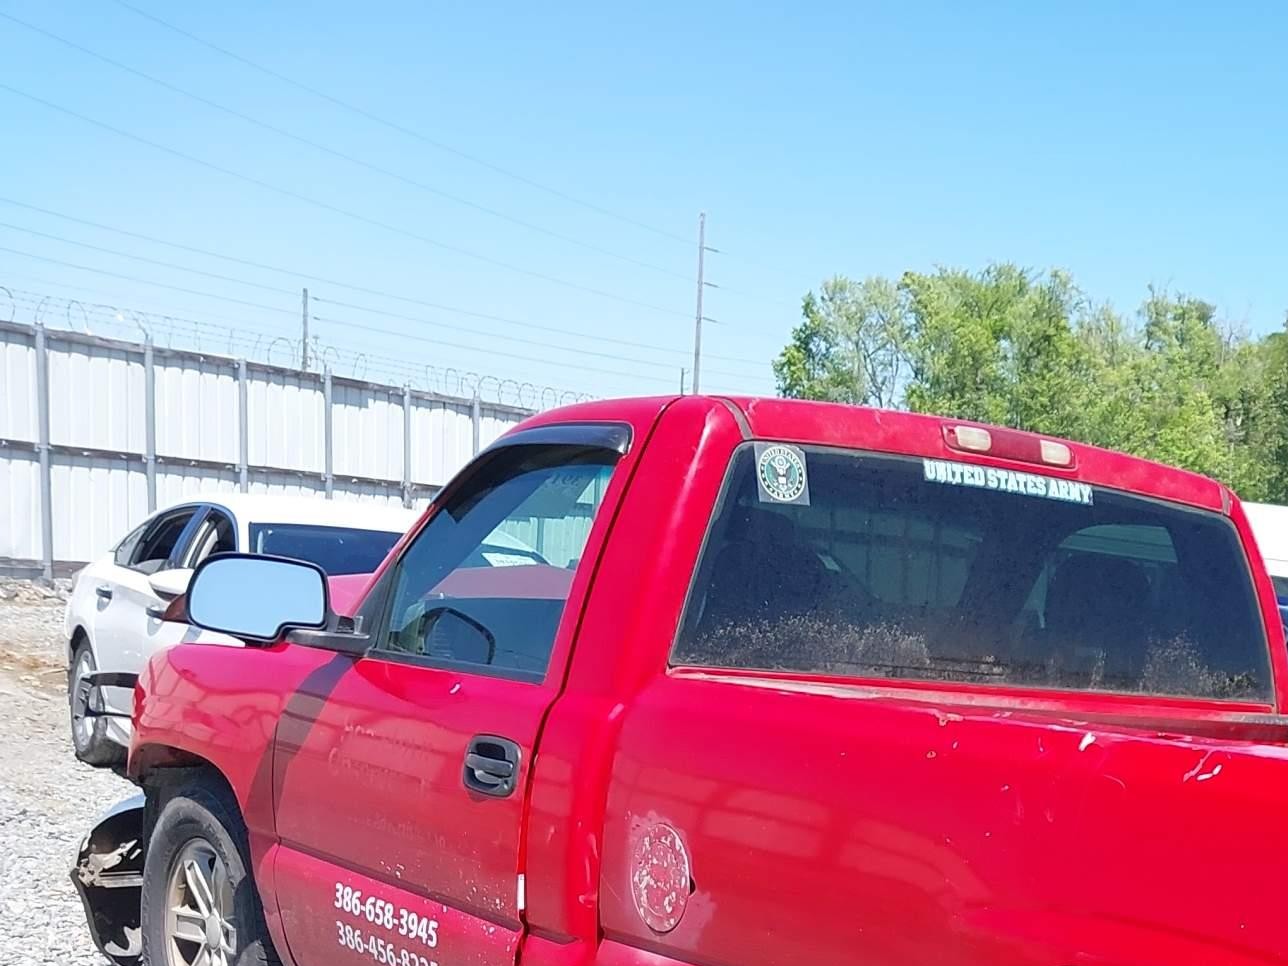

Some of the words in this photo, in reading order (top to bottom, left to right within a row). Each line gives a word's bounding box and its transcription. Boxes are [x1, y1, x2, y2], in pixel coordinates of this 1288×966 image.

[924, 459, 986, 486] UNITED
[987, 468, 1047, 495] STATES
[1048, 479, 1092, 505] ARMY
[334, 882, 438, 948] 386-658-3945
